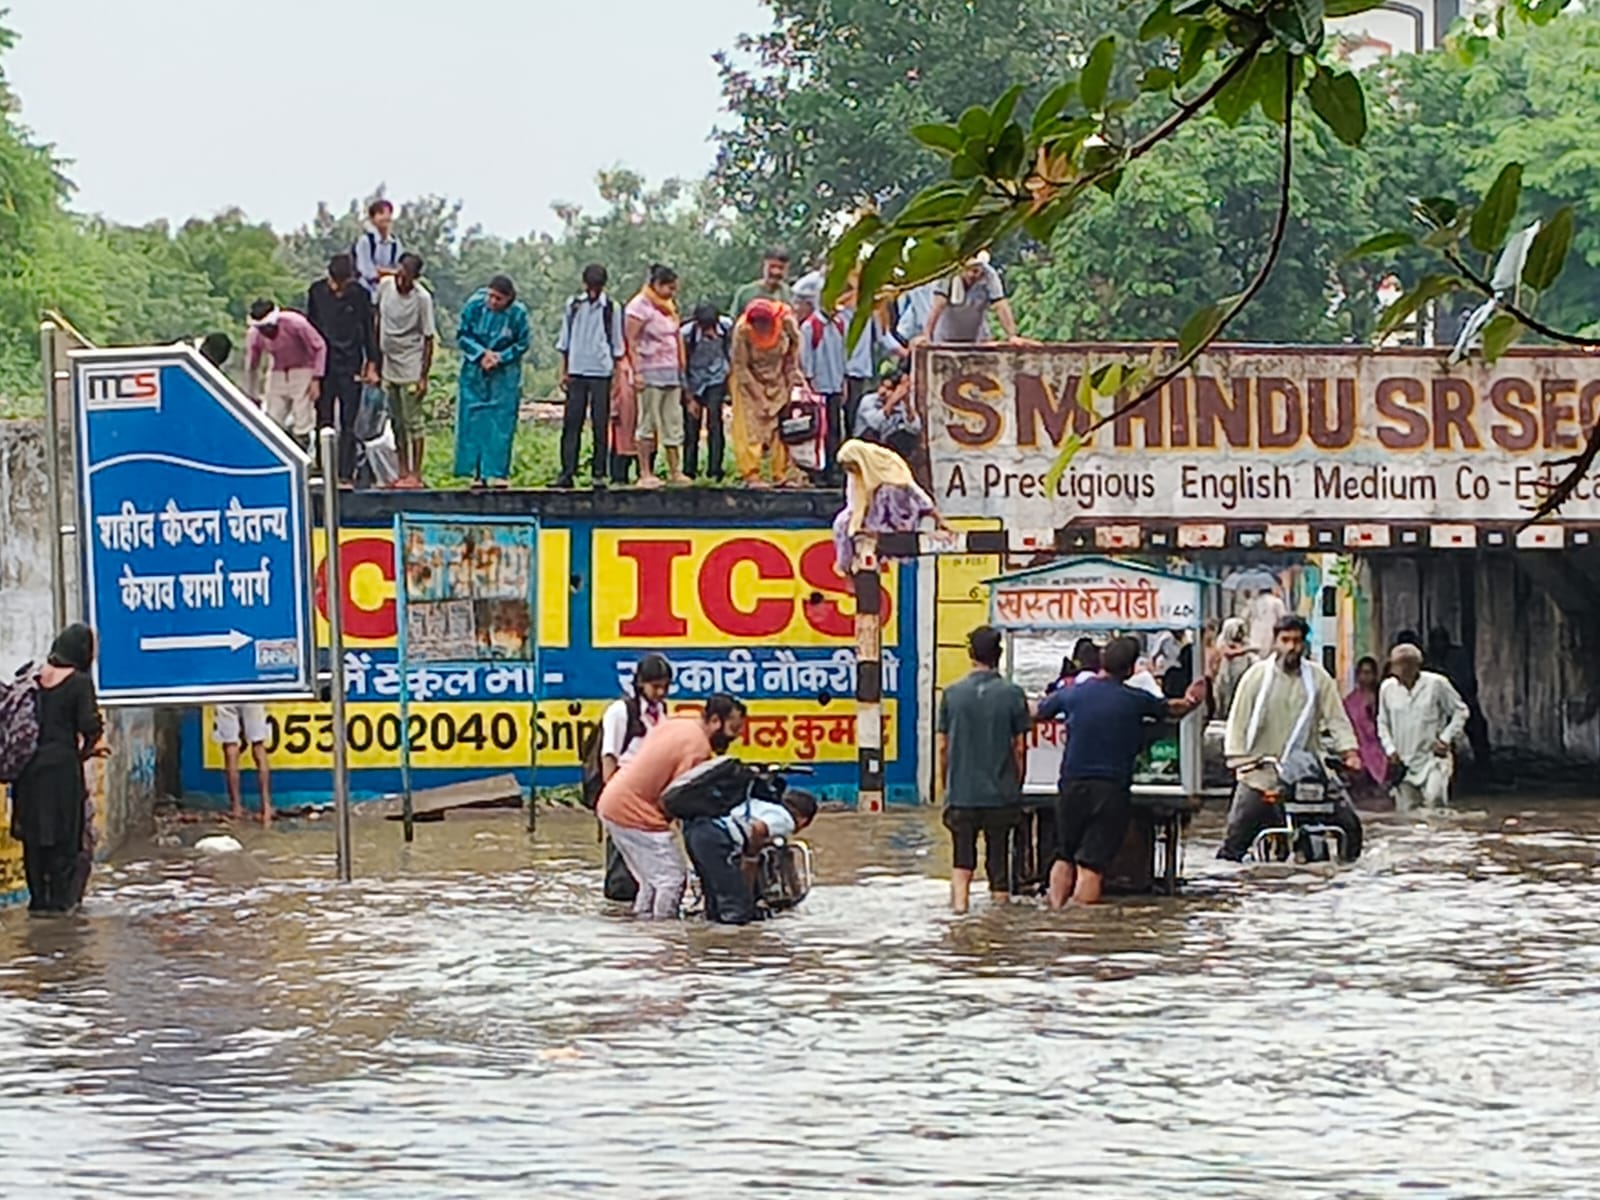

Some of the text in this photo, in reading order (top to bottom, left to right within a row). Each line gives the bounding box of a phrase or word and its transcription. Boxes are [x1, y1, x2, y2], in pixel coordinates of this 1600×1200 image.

[1113, 376, 1356, 449] HINDU
[1375, 377, 1482, 450] SR
[945, 464, 967, 498] A
[983, 463, 1155, 509] Prestigious
[1181, 465, 1291, 509] English
[1314, 465, 1436, 499] Medium
[97, 500, 155, 552] शहीद
[226, 496, 287, 543] चैतन्य
[119, 556, 271, 611] केशव शर्मा मार्ग
[618, 537, 893, 639] ICS
